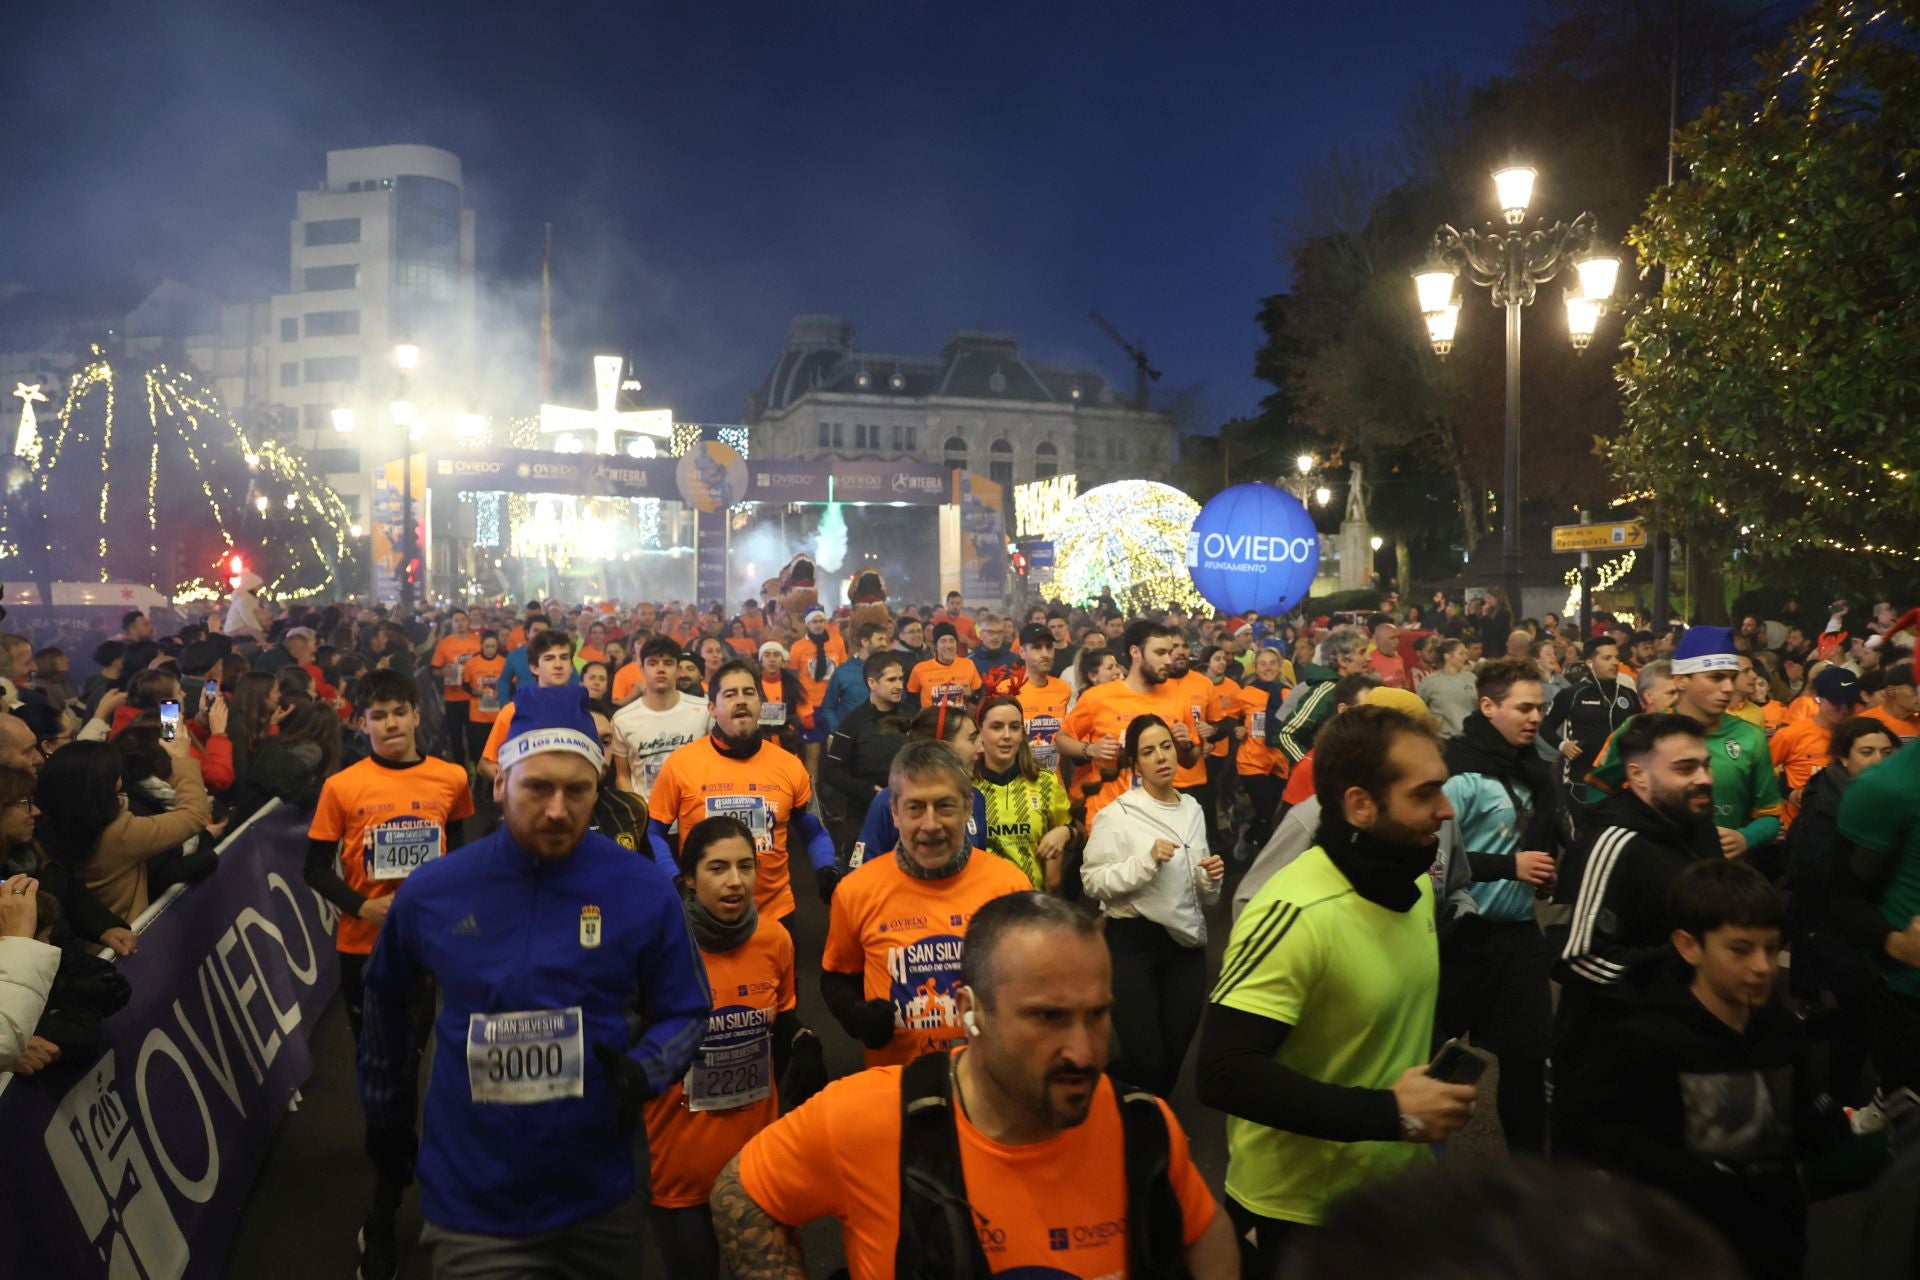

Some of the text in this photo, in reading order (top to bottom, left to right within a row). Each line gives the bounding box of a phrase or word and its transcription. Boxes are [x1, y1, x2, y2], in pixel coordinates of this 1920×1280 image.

[454, 460, 500, 474] OVIEDO
[532, 463, 578, 476] OVIEDO
[608, 468, 647, 482] INTEGRA
[771, 473, 812, 486] OVIEDO
[841, 475, 881, 487] OVIEDO
[908, 476, 943, 490] INTEGRA
[1203, 532, 1309, 564] OVIEDO
[1203, 560, 1268, 574] AYUNTAMIENTO
[532, 738, 550, 748] LOS
[714, 798, 722, 810] 41
[721, 798, 732, 806] SAN
[384, 831, 394, 844] 41
[394, 830, 406, 839] SAN
[987, 823, 1031, 838] NMR
[386, 844, 430, 867] 4052
[890, 915, 928, 929] OVIEDO
[887, 941, 964, 985] 41 SAN SILV
[933, 962, 943, 972] DE
[484, 1020, 497, 1044] 41
[497, 1019, 517, 1034] SAN
[518, 1015, 565, 1033] SILVESTRE
[707, 1016, 726, 1033] AN
[704, 1052, 714, 1067] 41
[714, 1050, 731, 1062] SAN
[731, 1043, 760, 1059] SILVESTRE
[487, 1042, 563, 1084] 3000
[706, 1063, 759, 1098] 2228
